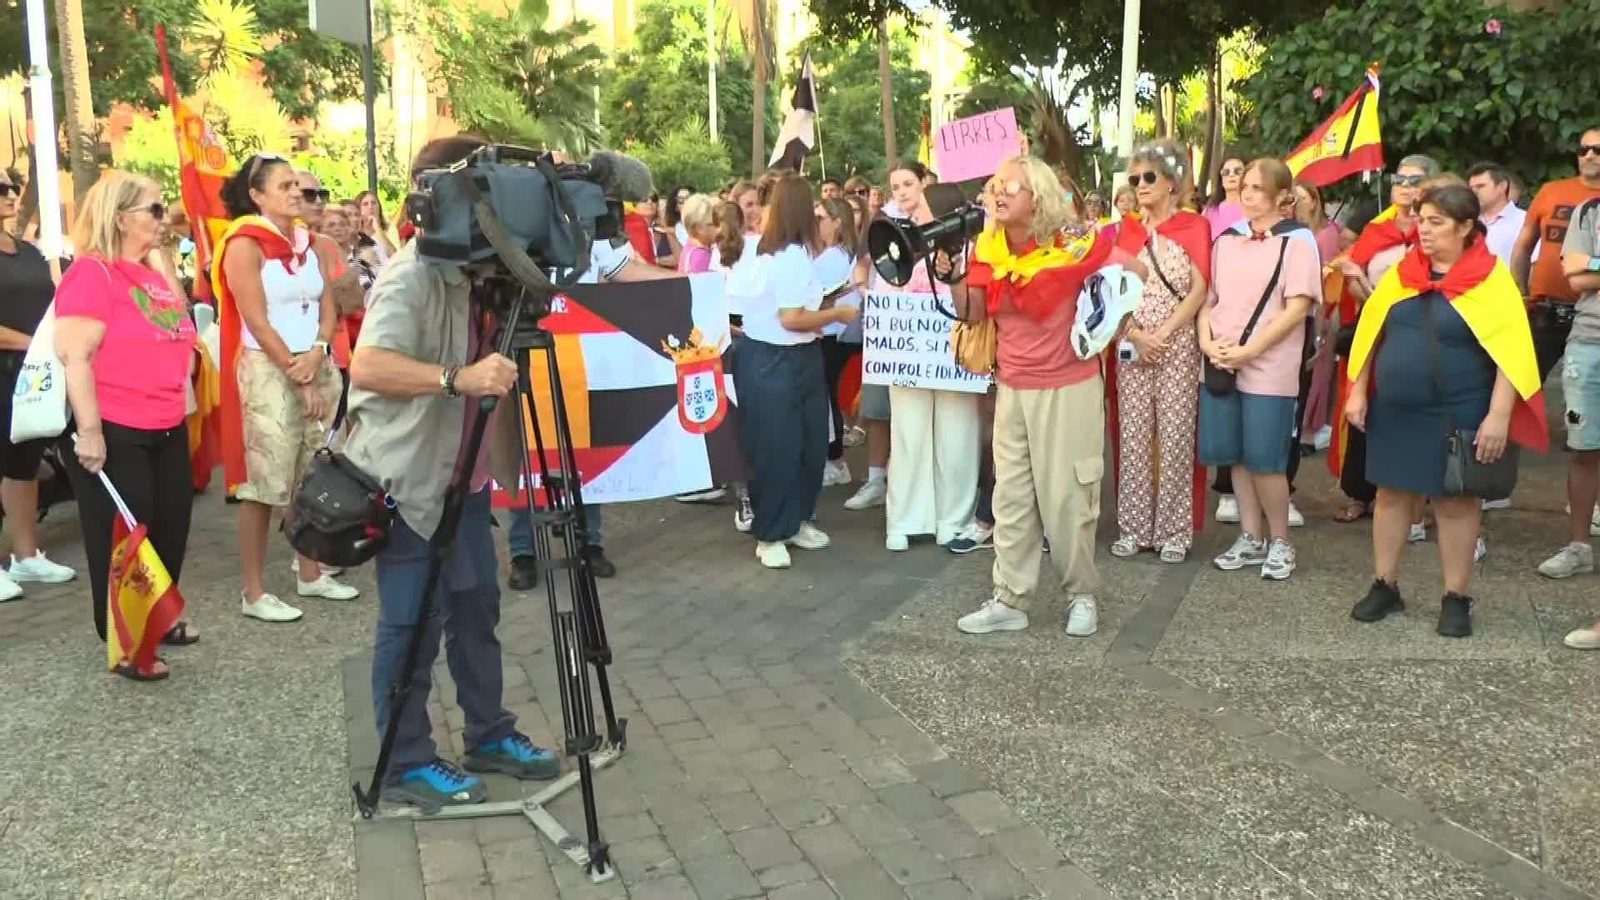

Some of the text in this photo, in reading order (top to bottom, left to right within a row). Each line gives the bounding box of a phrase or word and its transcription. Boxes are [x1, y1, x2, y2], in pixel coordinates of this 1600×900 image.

[941, 112, 1007, 152] LIBRES
[867, 294, 889, 309] NO
[890, 316, 951, 333] BUENOS
[925, 339, 939, 353] SI
[865, 360, 922, 377] CONTROL
